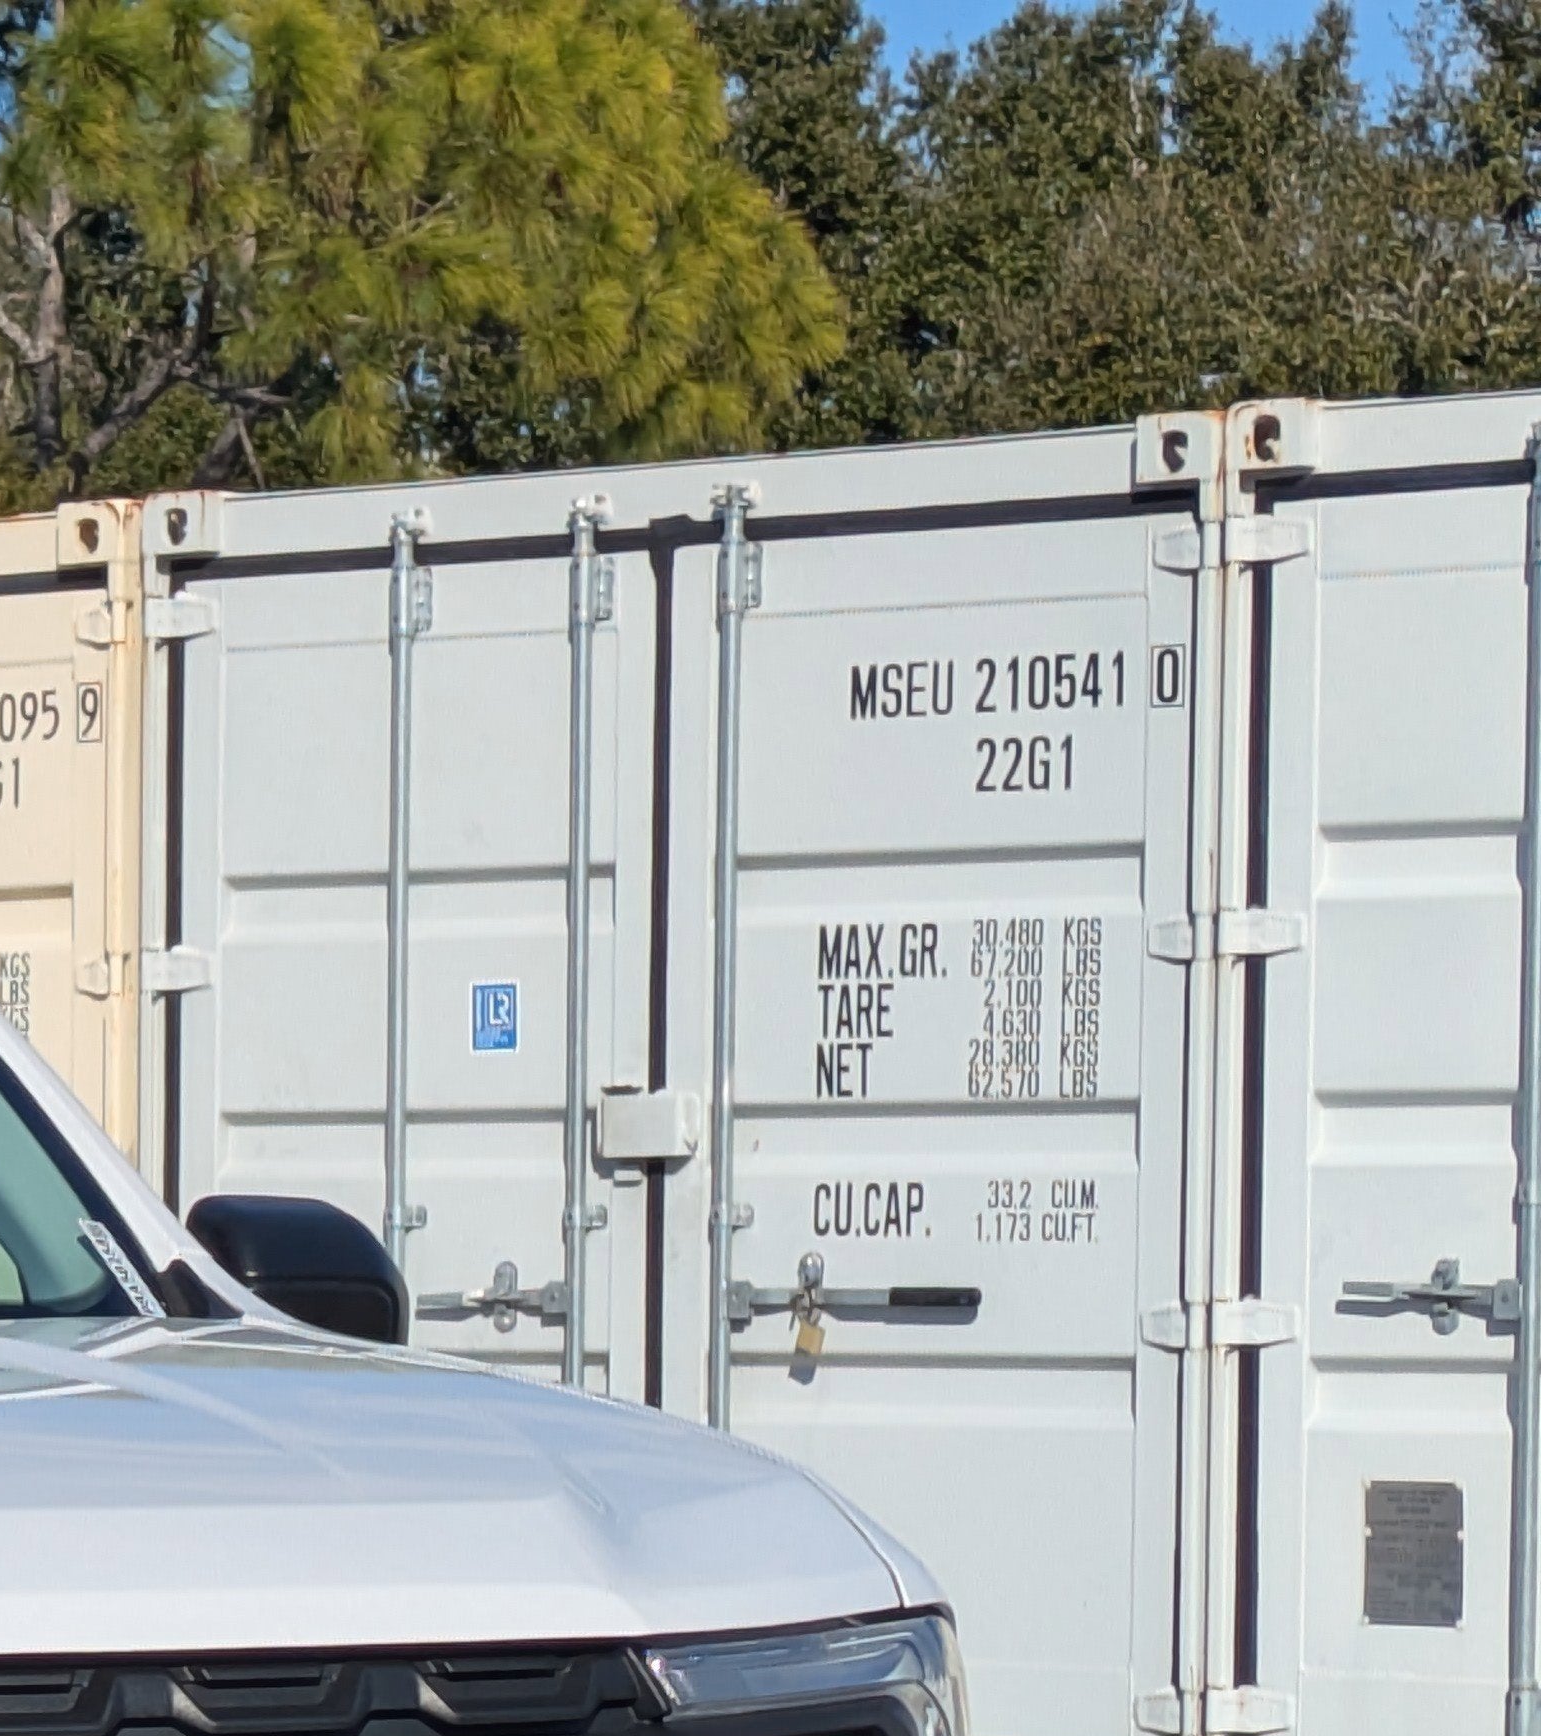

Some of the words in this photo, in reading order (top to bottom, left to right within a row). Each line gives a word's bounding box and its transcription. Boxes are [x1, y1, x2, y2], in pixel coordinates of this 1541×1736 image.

[849, 659, 955, 720] MSEU
[975, 649, 1125, 713] 210541
[1156, 648, 1180, 704] 0
[80, 687, 98, 739] 9
[975, 733, 1074, 792] 22G1
[0, 952, 30, 978] KGS
[818, 922, 948, 979] MAX.GR.
[1063, 916, 1102, 946] KGS
[1062, 947, 1101, 977] LBS
[818, 983, 894, 1039] TARE
[1061, 978, 1101, 1007] KGS
[816, 1043, 873, 1098] NET
